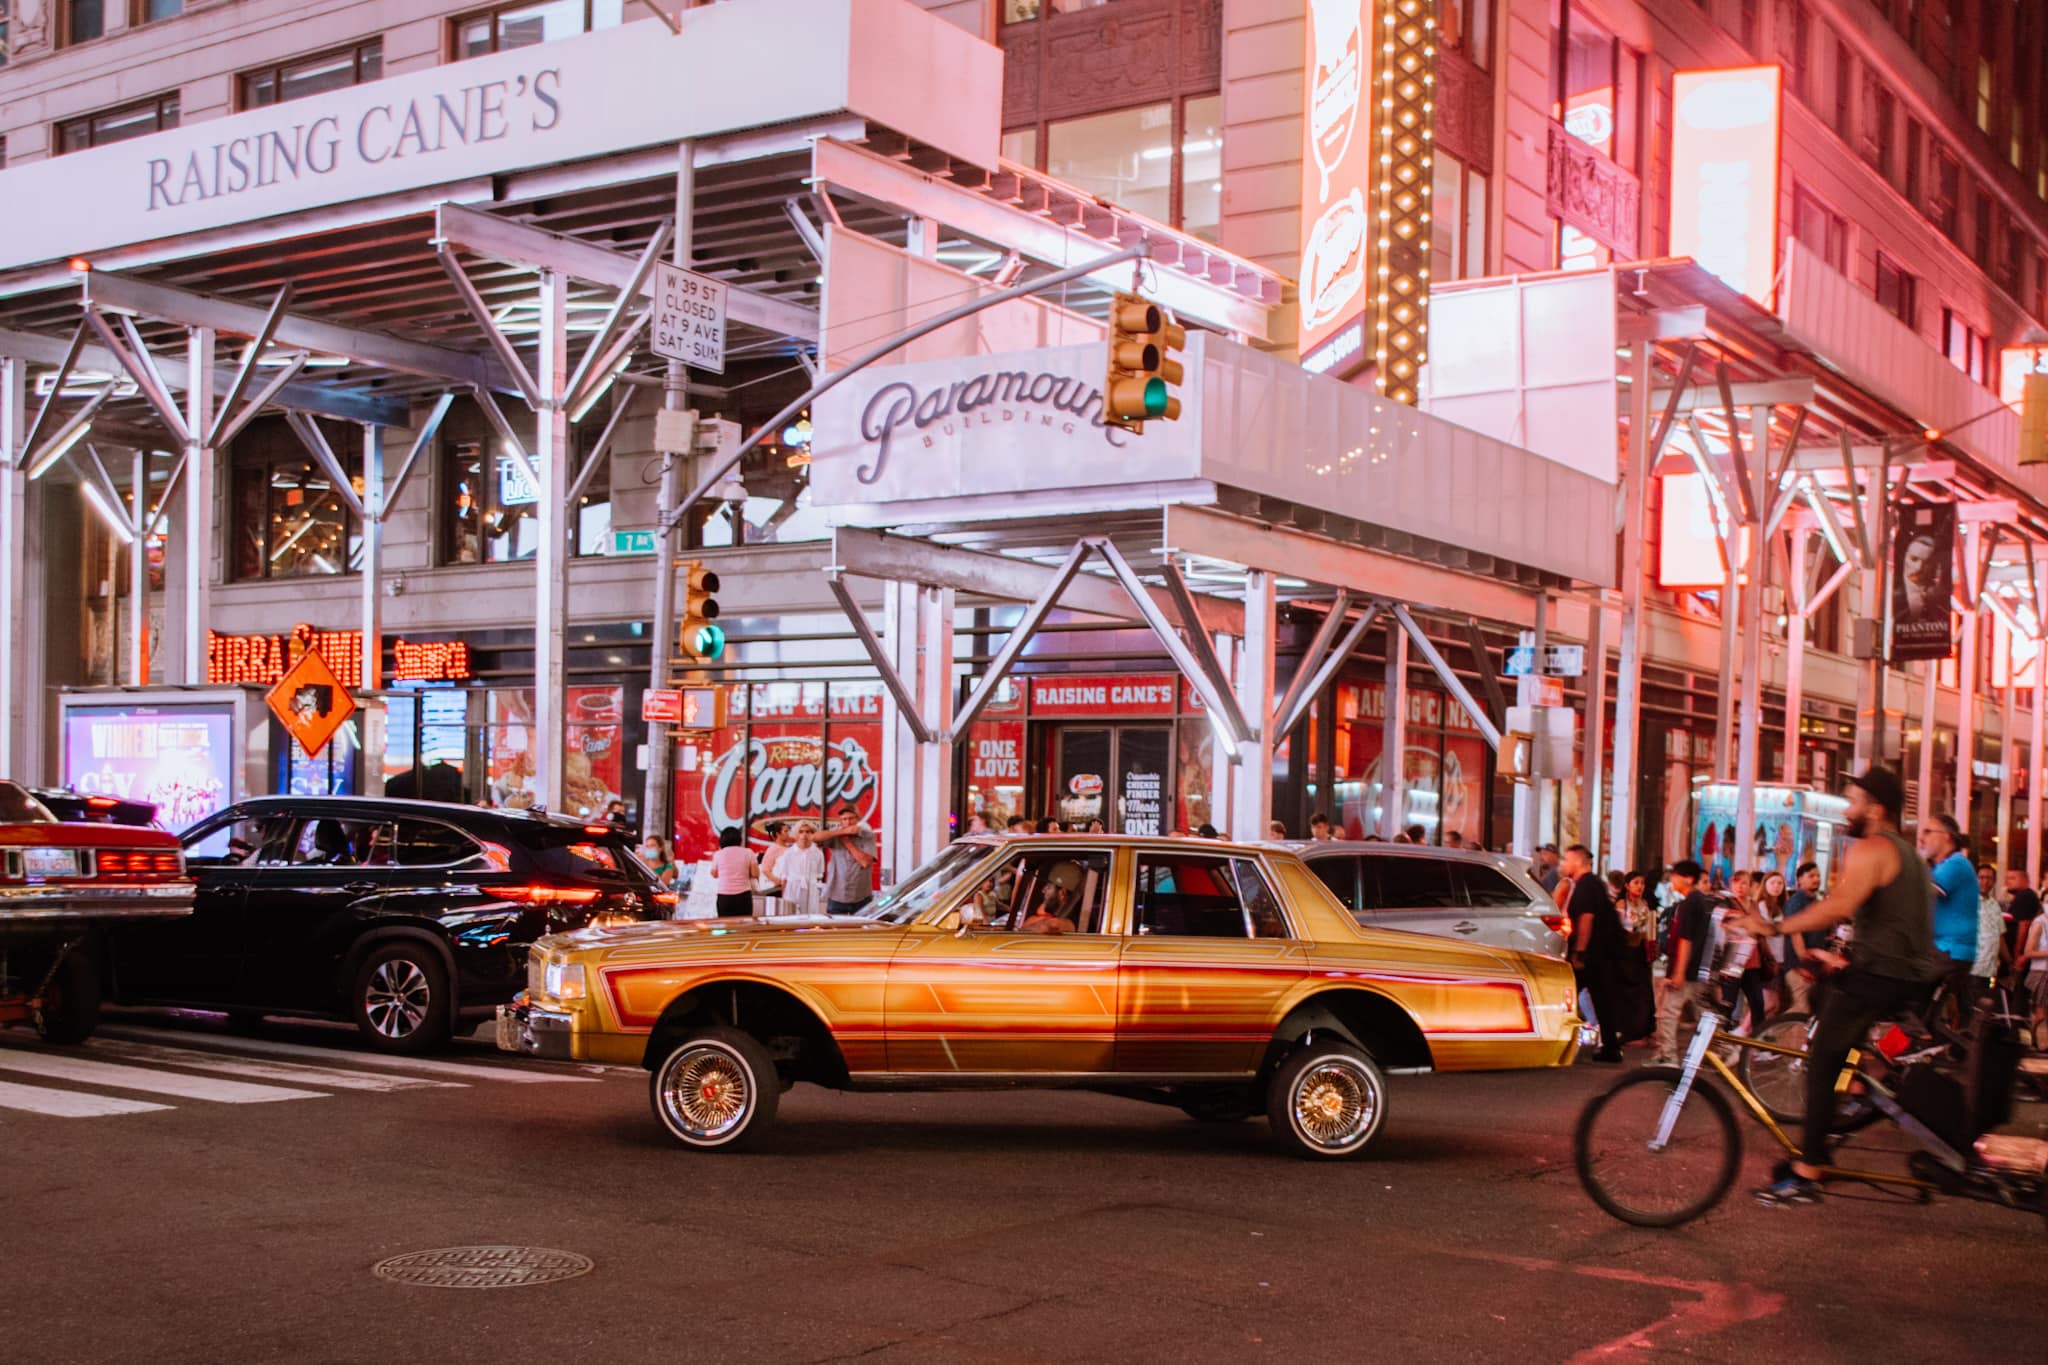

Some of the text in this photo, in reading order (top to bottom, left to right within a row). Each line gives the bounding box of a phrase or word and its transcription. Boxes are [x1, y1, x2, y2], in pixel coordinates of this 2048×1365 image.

[145, 67, 561, 211] RAISING CANE'S
[666, 273, 718, 302] W 39 ST
[666, 294, 717, 321] CLOSED
[661, 313, 720, 343] AT 9 AVE
[921, 408, 1076, 449] BUILDING
[1037, 687, 1107, 705] RAISING
[1111, 685, 1173, 704] CANE'S
[979, 739, 1017, 758] ONE
[974, 758, 1020, 777] LOVE
[1126, 781, 1160, 790] CHICKEN
[1125, 819, 1160, 836] ONE
